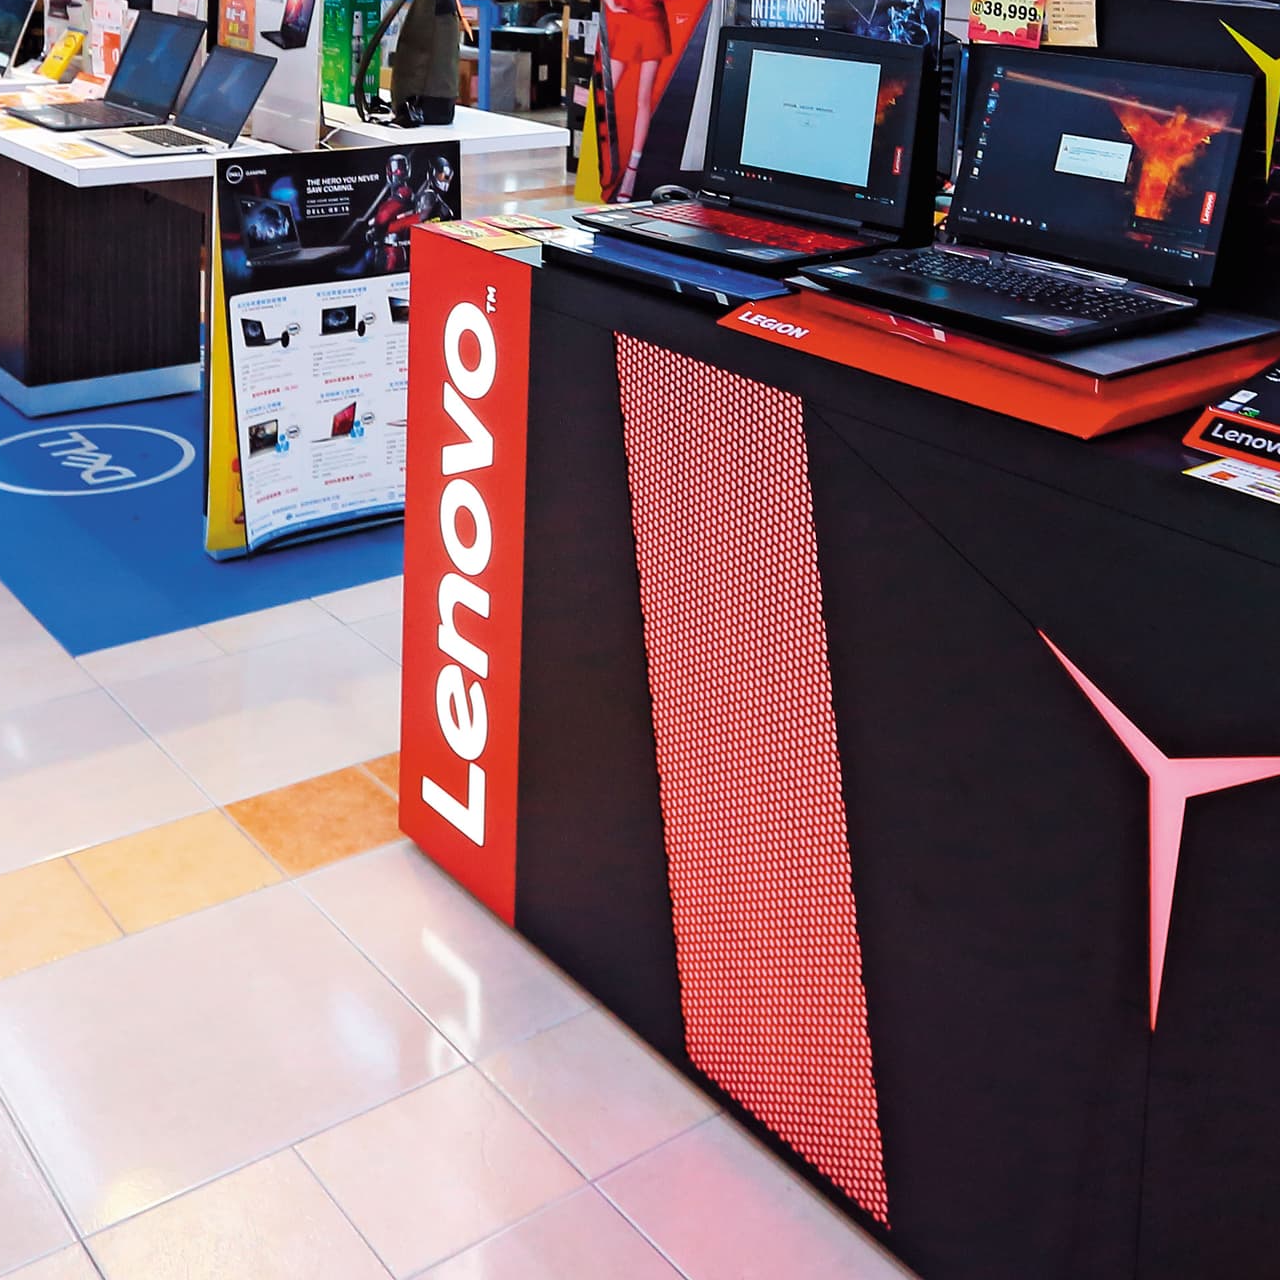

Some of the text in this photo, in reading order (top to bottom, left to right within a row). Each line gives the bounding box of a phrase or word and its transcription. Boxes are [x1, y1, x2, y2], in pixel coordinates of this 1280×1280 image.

[983, 0, 1039, 23] 38,999
[306, 173, 380, 187] THE HERO YOU NEVER
[1202, 193, 1215, 223] Lenovo
[738, 310, 809, 341] LEGION
[37, 431, 137, 486] DELL
[421, 300, 498, 848] Lenovo
